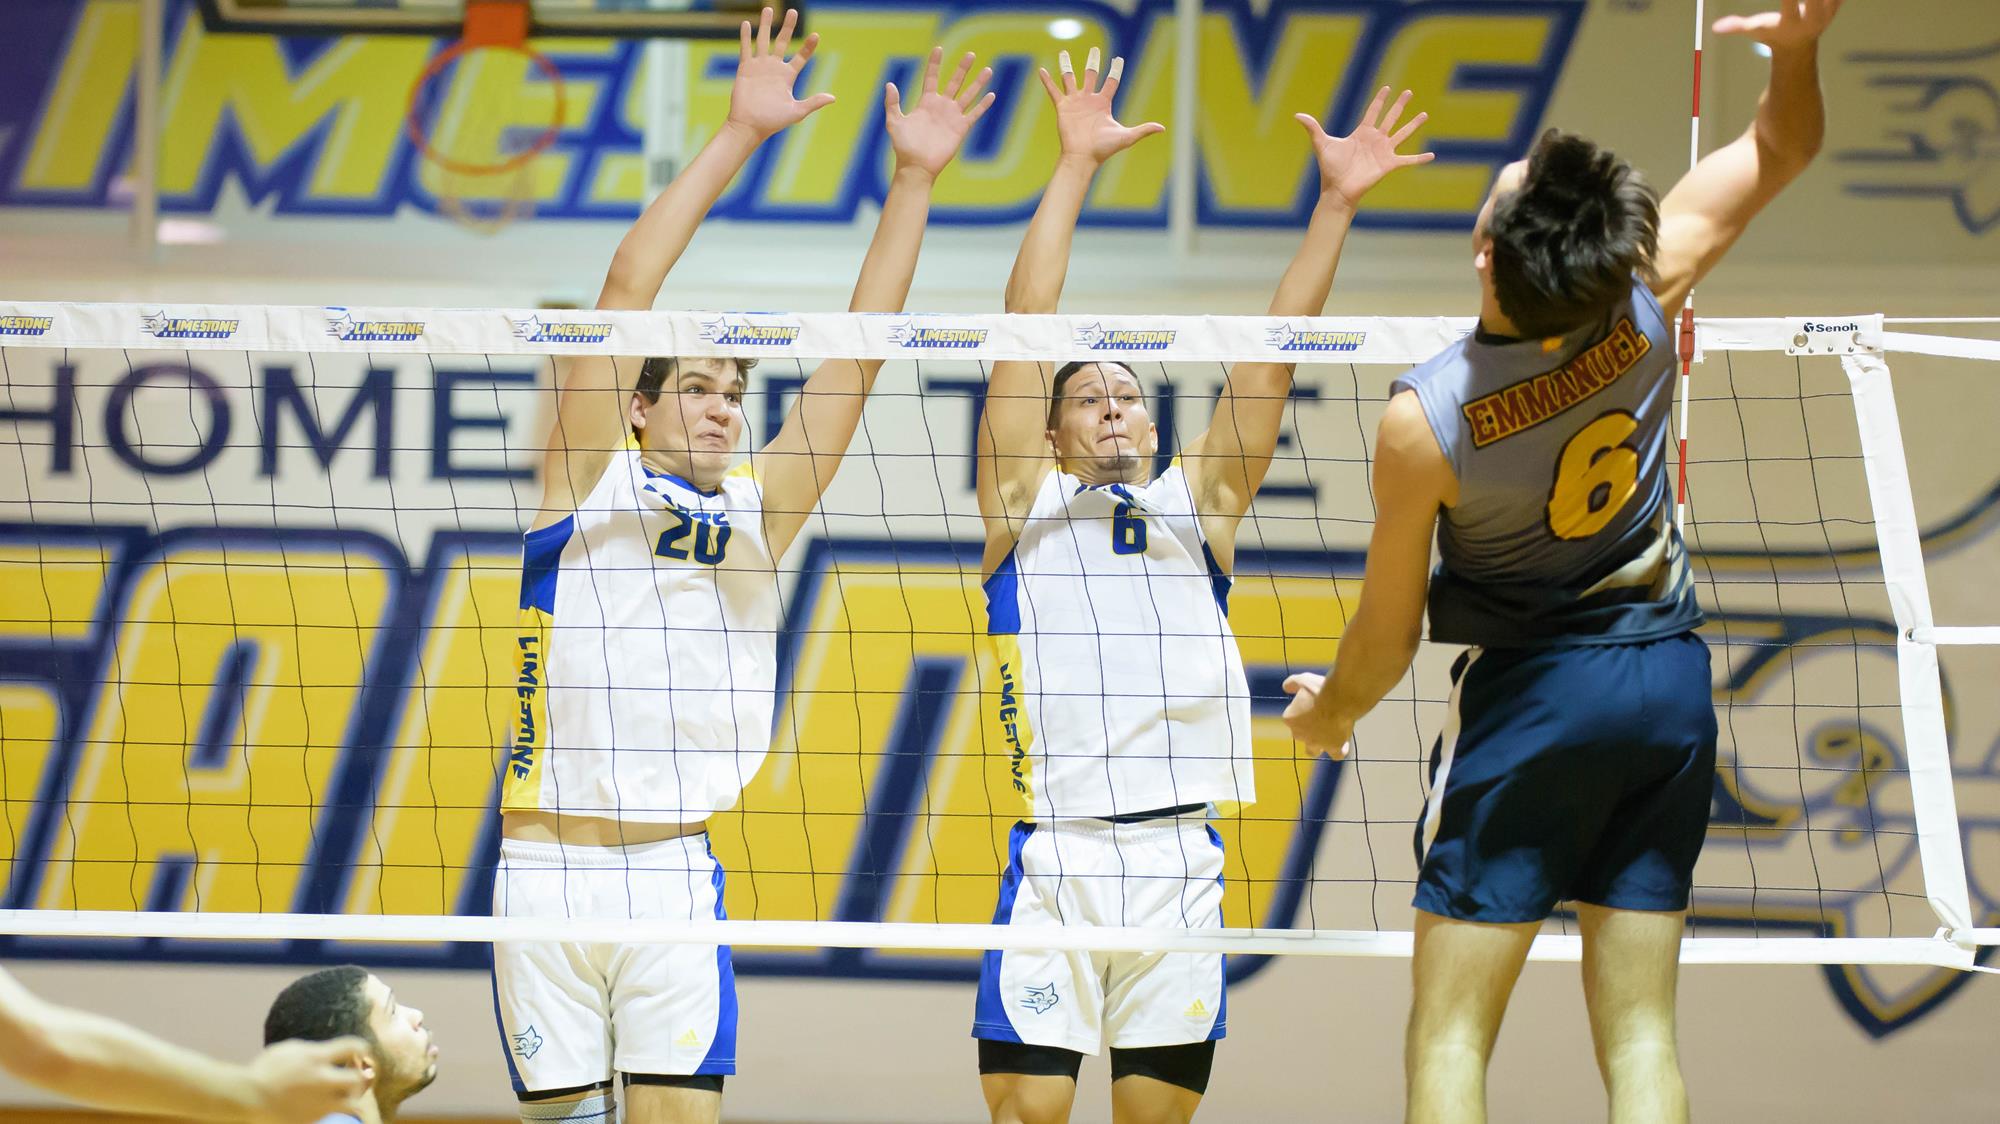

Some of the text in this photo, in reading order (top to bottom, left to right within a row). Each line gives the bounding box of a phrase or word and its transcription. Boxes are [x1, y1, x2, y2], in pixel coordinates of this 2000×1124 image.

[0, 0, 1587, 232] IMESTONE
[168, 320, 239, 333] LIMESTONE
[354, 322, 425, 335] LIMESTONE
[541, 323, 612, 337] LIMESTONE
[728, 326, 800, 339] LIMESTONE
[1816, 322, 1858, 333] Senoh
[916, 329, 987, 343] LIMESTONE
[1104, 331, 1176, 344] LIMESTONE
[1294, 332, 1366, 345] LIMESTONE
[1462, 318, 1652, 449] EMMANUEL
[1546, 408, 1640, 541] 6
[1111, 500, 1148, 556] 6
[655, 506, 732, 566] 20
